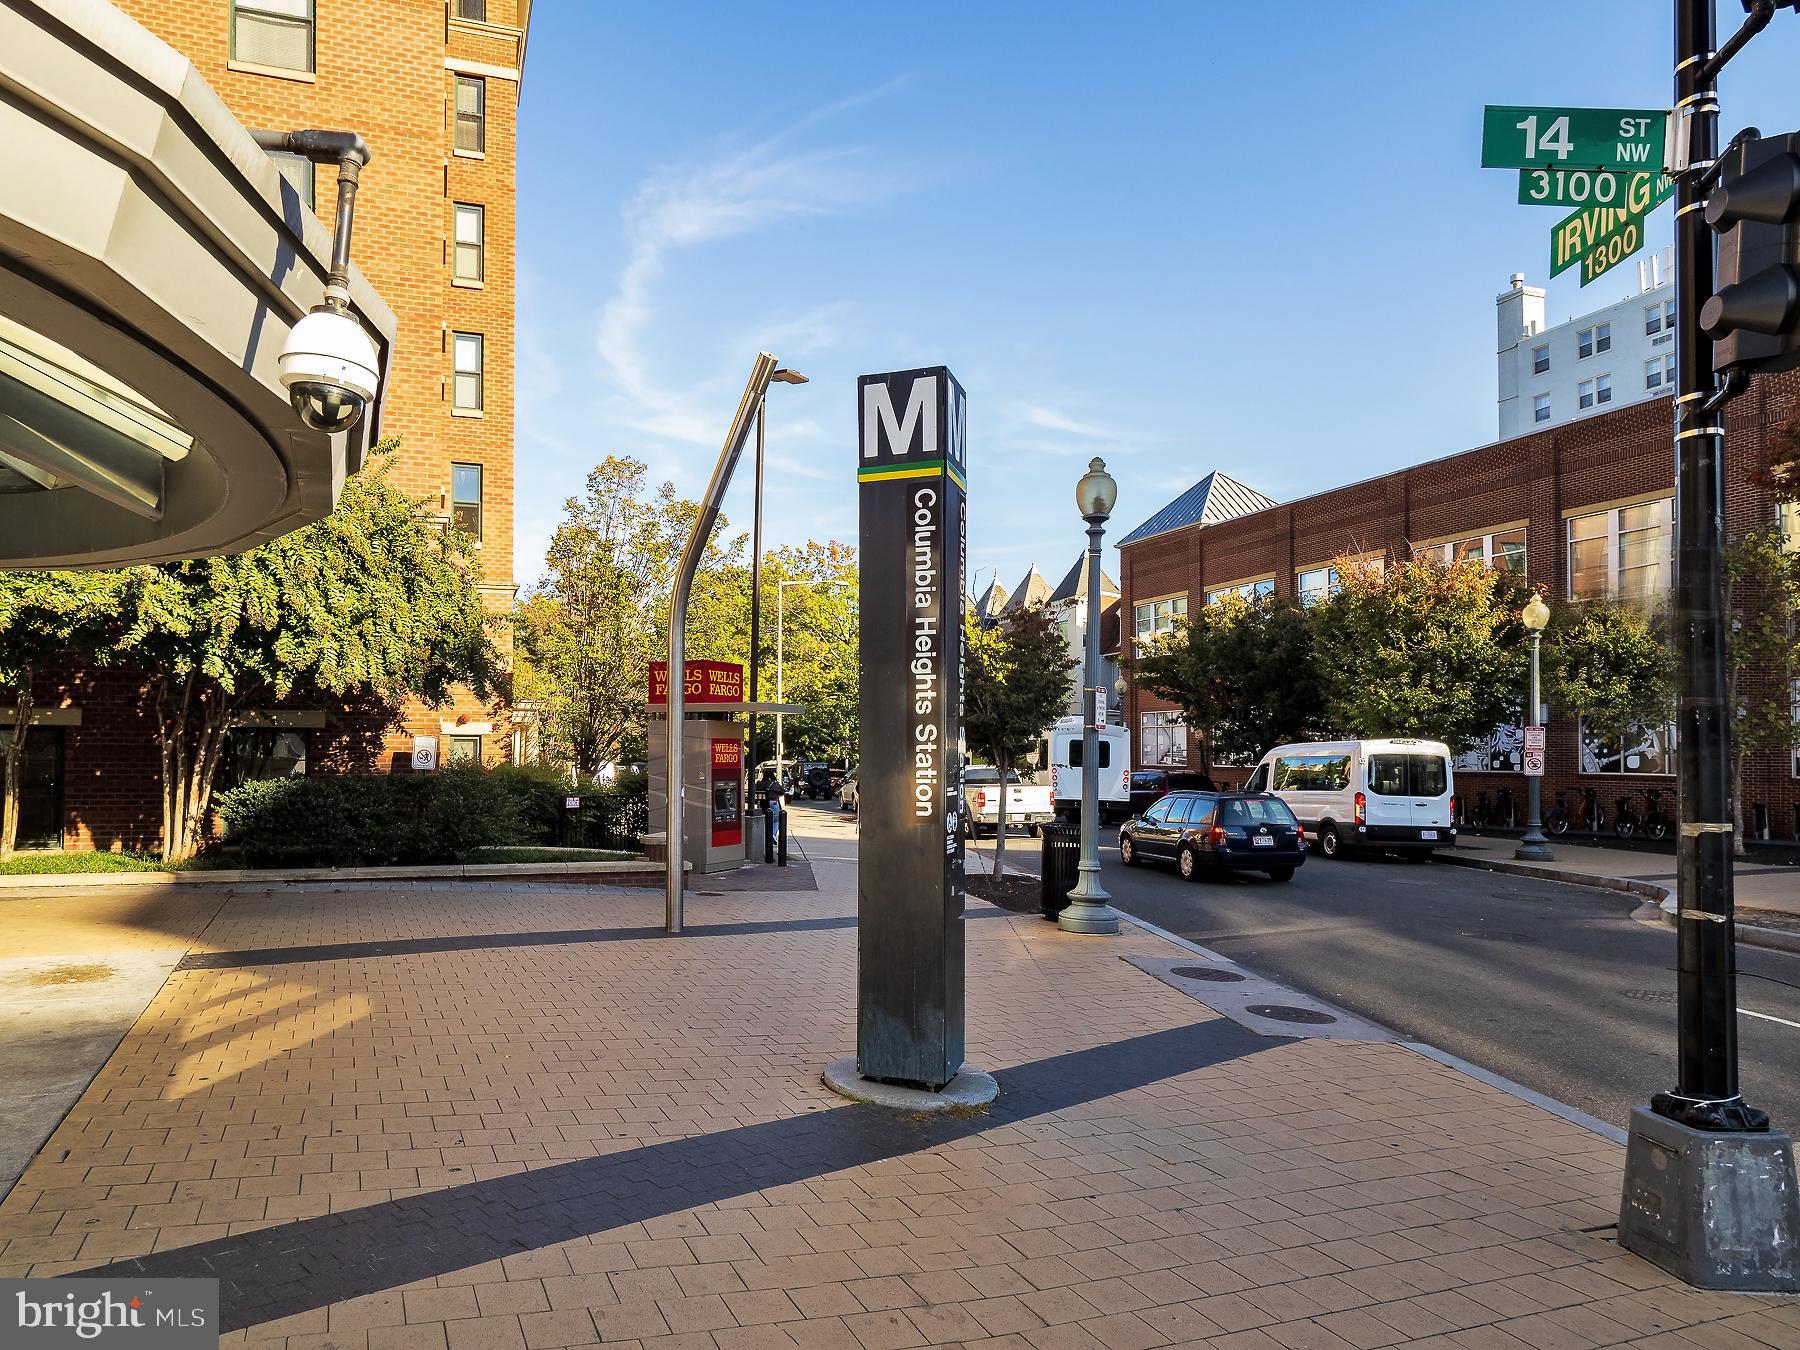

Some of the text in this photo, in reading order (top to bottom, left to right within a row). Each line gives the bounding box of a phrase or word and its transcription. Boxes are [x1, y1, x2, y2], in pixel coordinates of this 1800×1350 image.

[1516, 115, 1651, 160] 14 ST
[1616, 142, 1651, 162] NW
[1529, 170, 1617, 203] 3100
[1585, 224, 1637, 280] 1300
[863, 375, 937, 458] M
[947, 377, 966, 470] M
[910, 488, 938, 817] Columbia Heights Station
[654, 669, 702, 681] WLS
[709, 669, 740, 684] WELLS
[655, 683, 702, 695] FGO
[709, 683, 740, 697] FARGO
[714, 743, 738, 753] WELLS
[714, 753, 738, 763] FARGO
